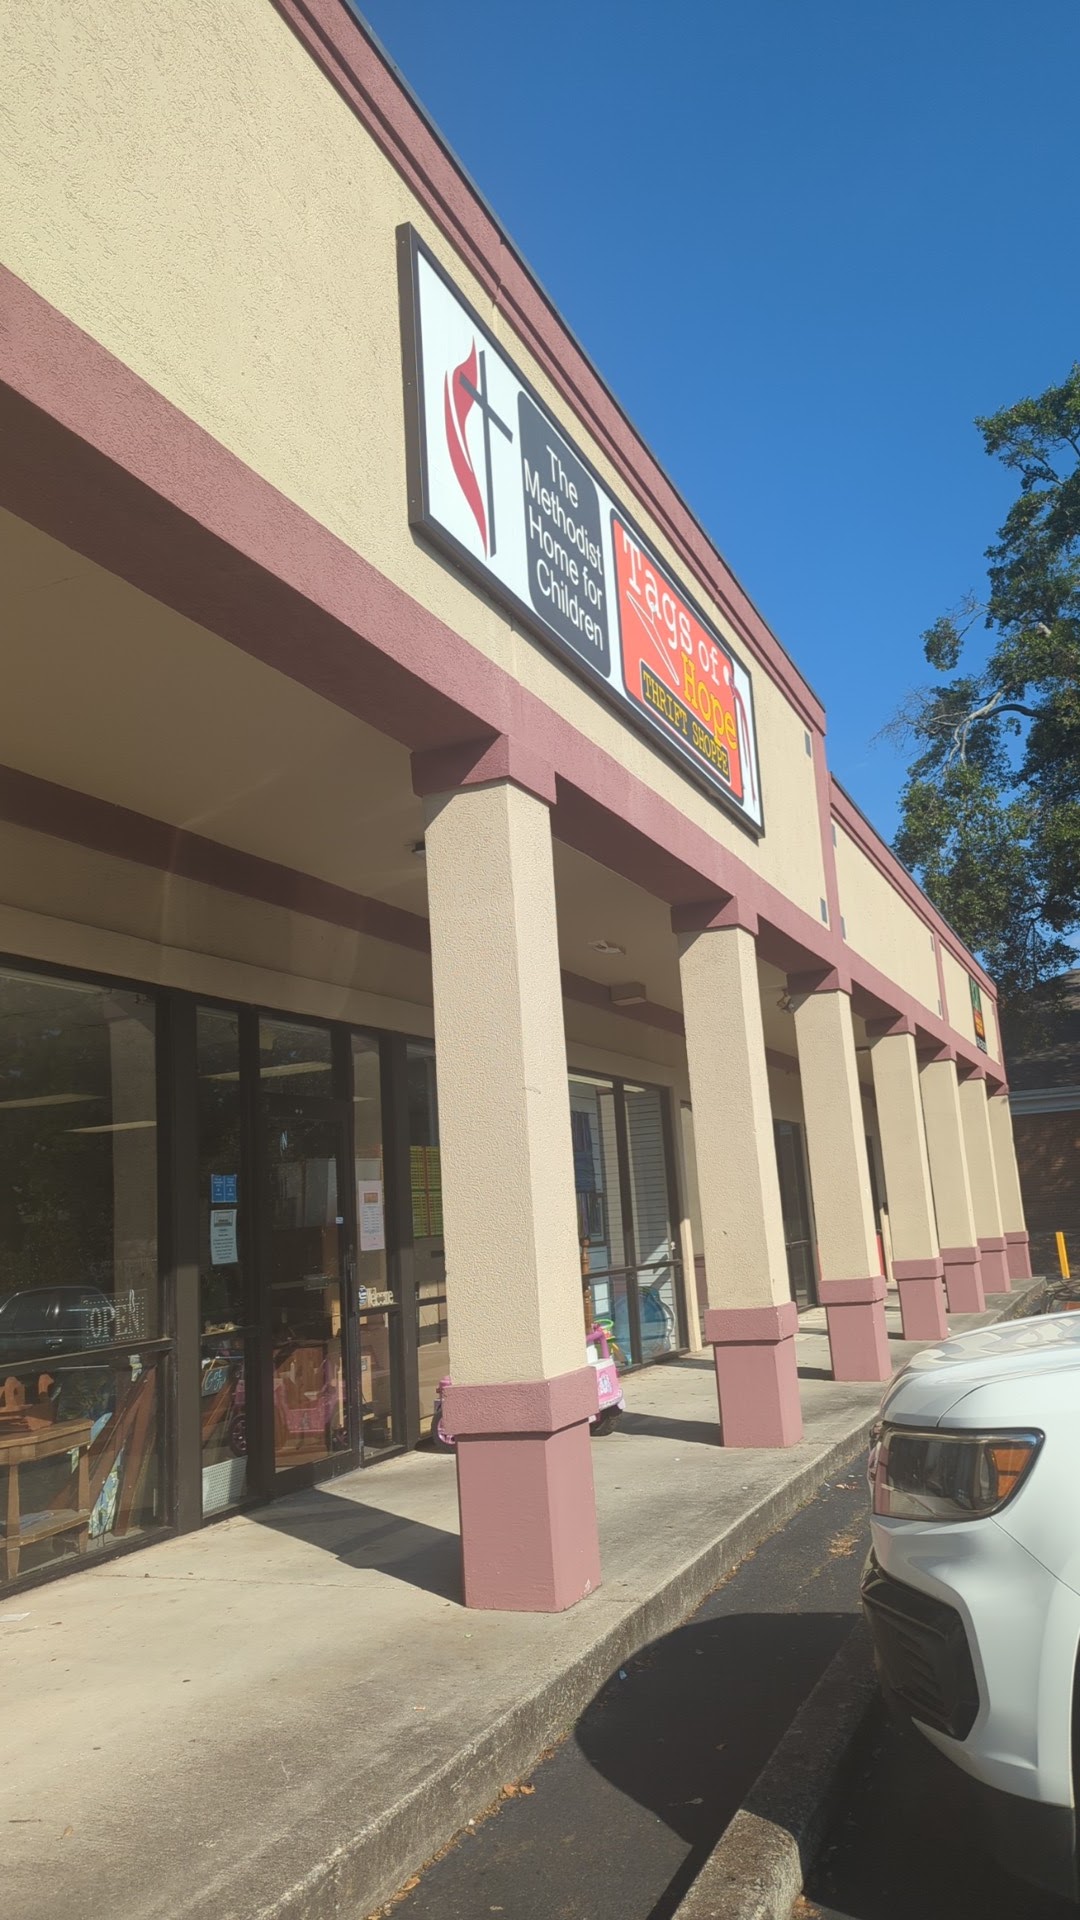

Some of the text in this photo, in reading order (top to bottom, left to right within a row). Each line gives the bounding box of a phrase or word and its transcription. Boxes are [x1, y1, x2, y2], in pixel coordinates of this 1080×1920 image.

[524, 457, 603, 575] Methodist
[546, 445, 579, 509] The
[528, 505, 603, 611] Home for
[536, 558, 604, 651] Children
[623, 529, 719, 686] Tags of
[643, 670, 729, 776] THRIFT SHOPPE
[681, 650, 738, 750] Hope
[90, 1303, 140, 1338] OPEN
